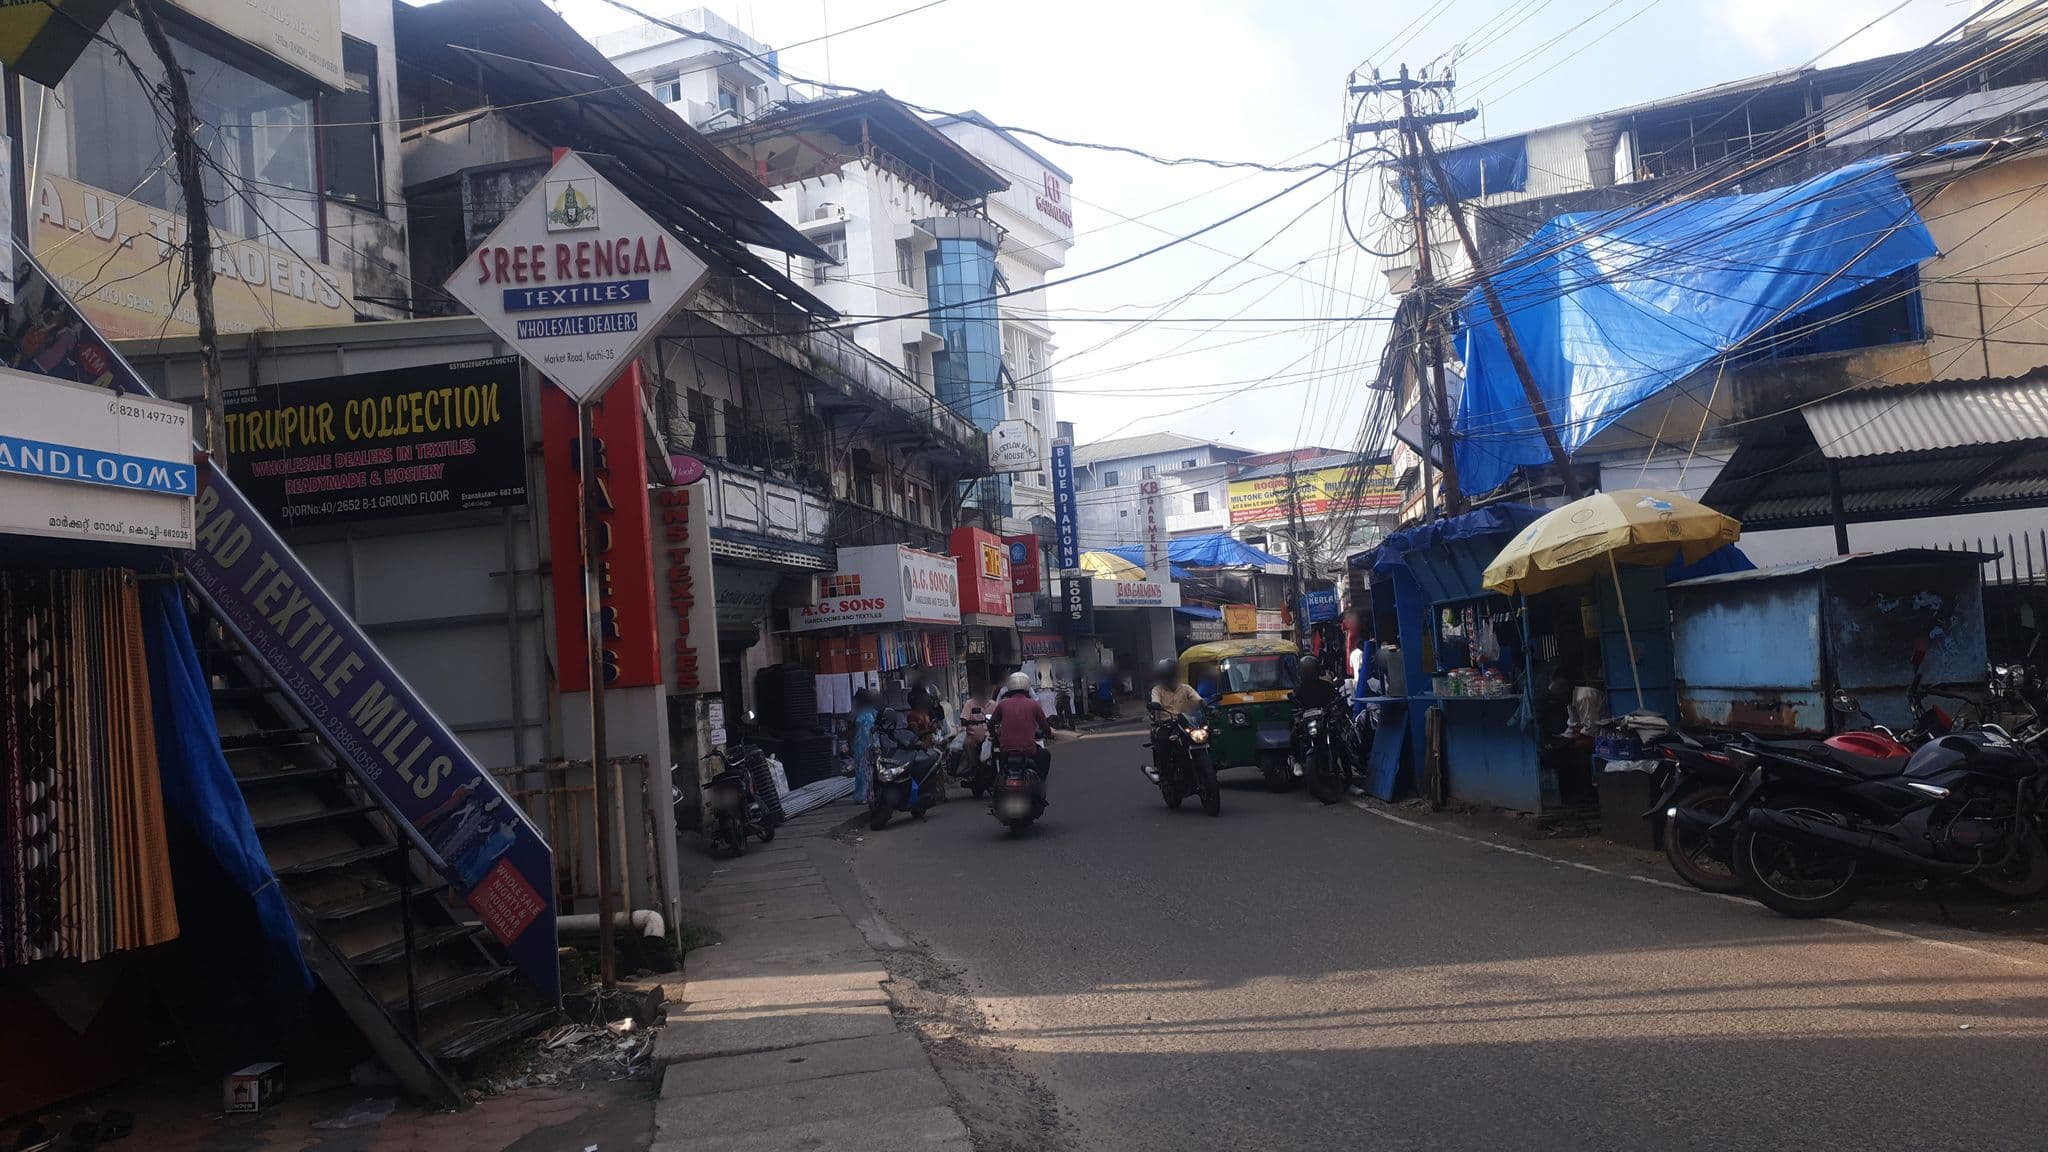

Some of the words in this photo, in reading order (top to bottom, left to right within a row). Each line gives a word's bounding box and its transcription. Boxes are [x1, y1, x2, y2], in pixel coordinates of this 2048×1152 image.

[38, 178, 133, 249] A.U.
[149, 213, 342, 309] TADERS
[478, 244, 547, 285] SREE
[555, 234, 672, 281] RENGAA
[524, 284, 631, 306] TEXTILES
[517, 317, 585, 339] WHOLESALE
[588, 312, 638, 333] DEALERS
[81, 346, 105, 373] ATM
[543, 353, 565, 364] Market
[566, 351, 585, 363] Road,
[586, 349, 615, 361] Kochi-35
[119, 405, 186, 427] 8281497379
[223, 402, 336, 454] TIRUPUR
[344, 382, 501, 441] COLLECTION
[251, 453, 332, 478] WHOLESALE
[335, 446, 394, 469] DEALERS
[396, 445, 413, 462] IN
[416, 438, 476, 462] TEXTILES
[998, 441, 1020, 453] CEYLON
[1004, 451, 1025, 460] HOUSE
[284, 471, 367, 496] READYMADE
[369, 470, 382, 486] &
[384, 463, 446, 484] HOSIERY
[1056, 447, 1068, 490] BLUE
[362, 497, 378, 511] B-1
[378, 493, 417, 508] GROUND
[419, 489, 450, 504] FLOOR
[1139, 482, 1159, 495] KB
[1230, 492, 1263, 504] MILTONE
[659, 489, 690, 543] MNS
[928, 569, 950, 594] SONS
[801, 602, 835, 617] A.G.
[838, 597, 886, 613] SONS
[1069, 579, 1083, 621] ROOMS
[668, 547, 699, 690] TEXTILES
[855, 612, 882, 620] TEXTILES
[240, 551, 366, 699] TEXTILE
[348, 679, 453, 800] MILLS
[492, 879, 521, 912] NIGHTY
[495, 864, 523, 896] WHOLE
[520, 893, 541, 917] SALE
